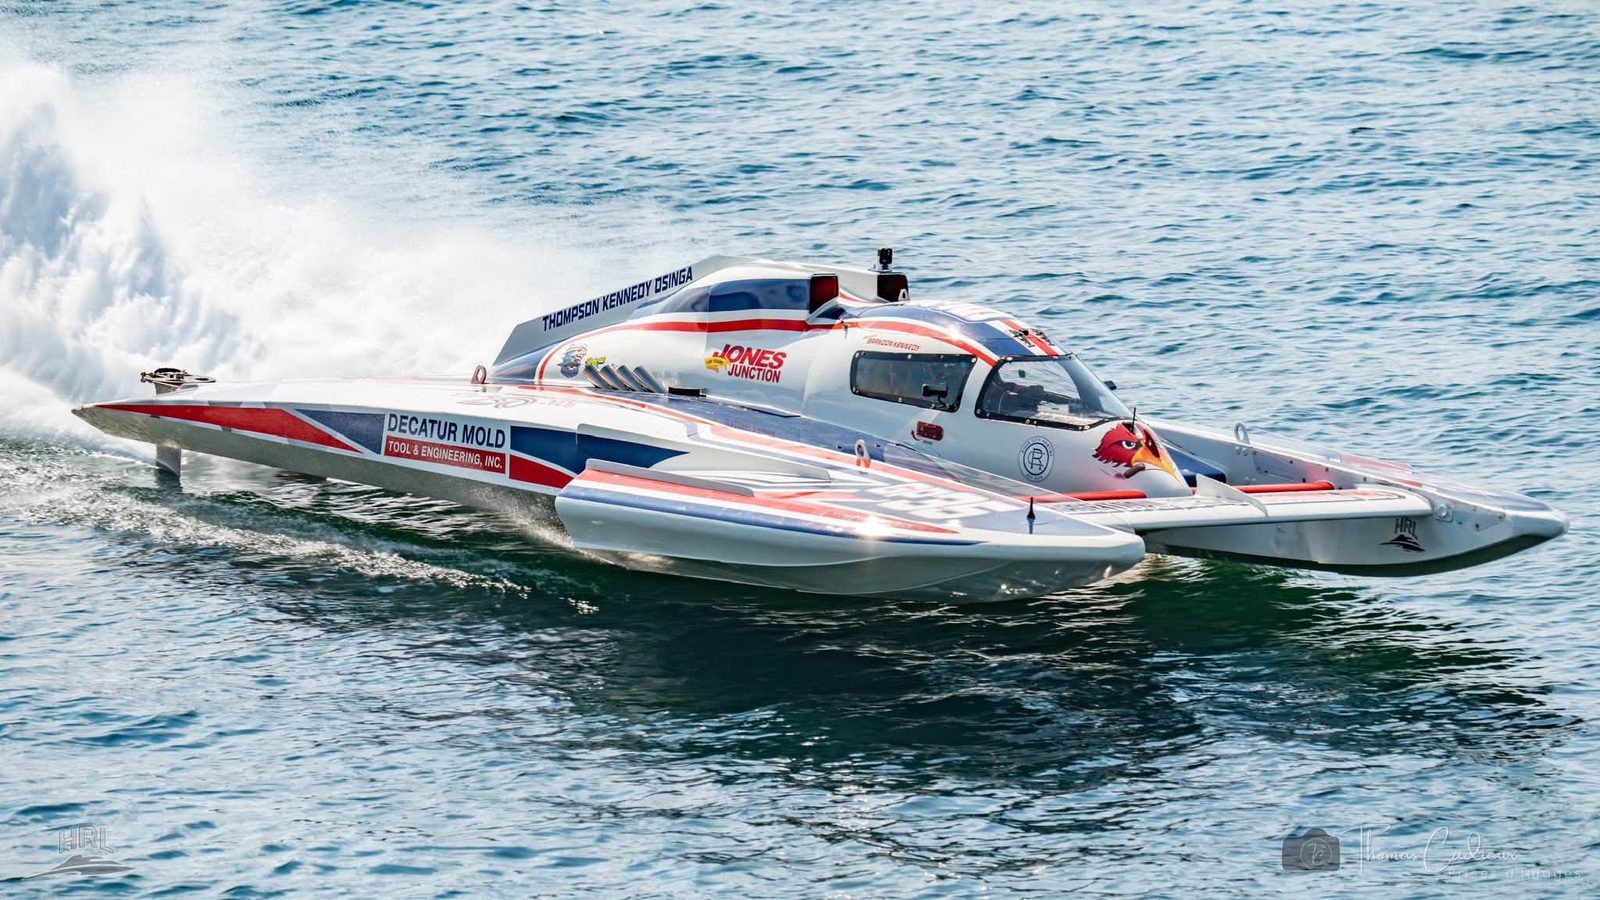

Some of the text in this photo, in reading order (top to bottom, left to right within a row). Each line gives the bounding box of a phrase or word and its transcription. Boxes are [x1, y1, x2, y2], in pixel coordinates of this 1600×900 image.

[543, 266, 693, 331] THOMPSON KENNEDY OSINGA
[713, 344, 787, 369] JONES
[728, 364, 781, 383] JUNCTION
[387, 413, 506, 449] DECATUR MOLD
[388, 440, 503, 468] TOOL & ENGINEERING, INC.
[1394, 517, 1418, 540] HRL
